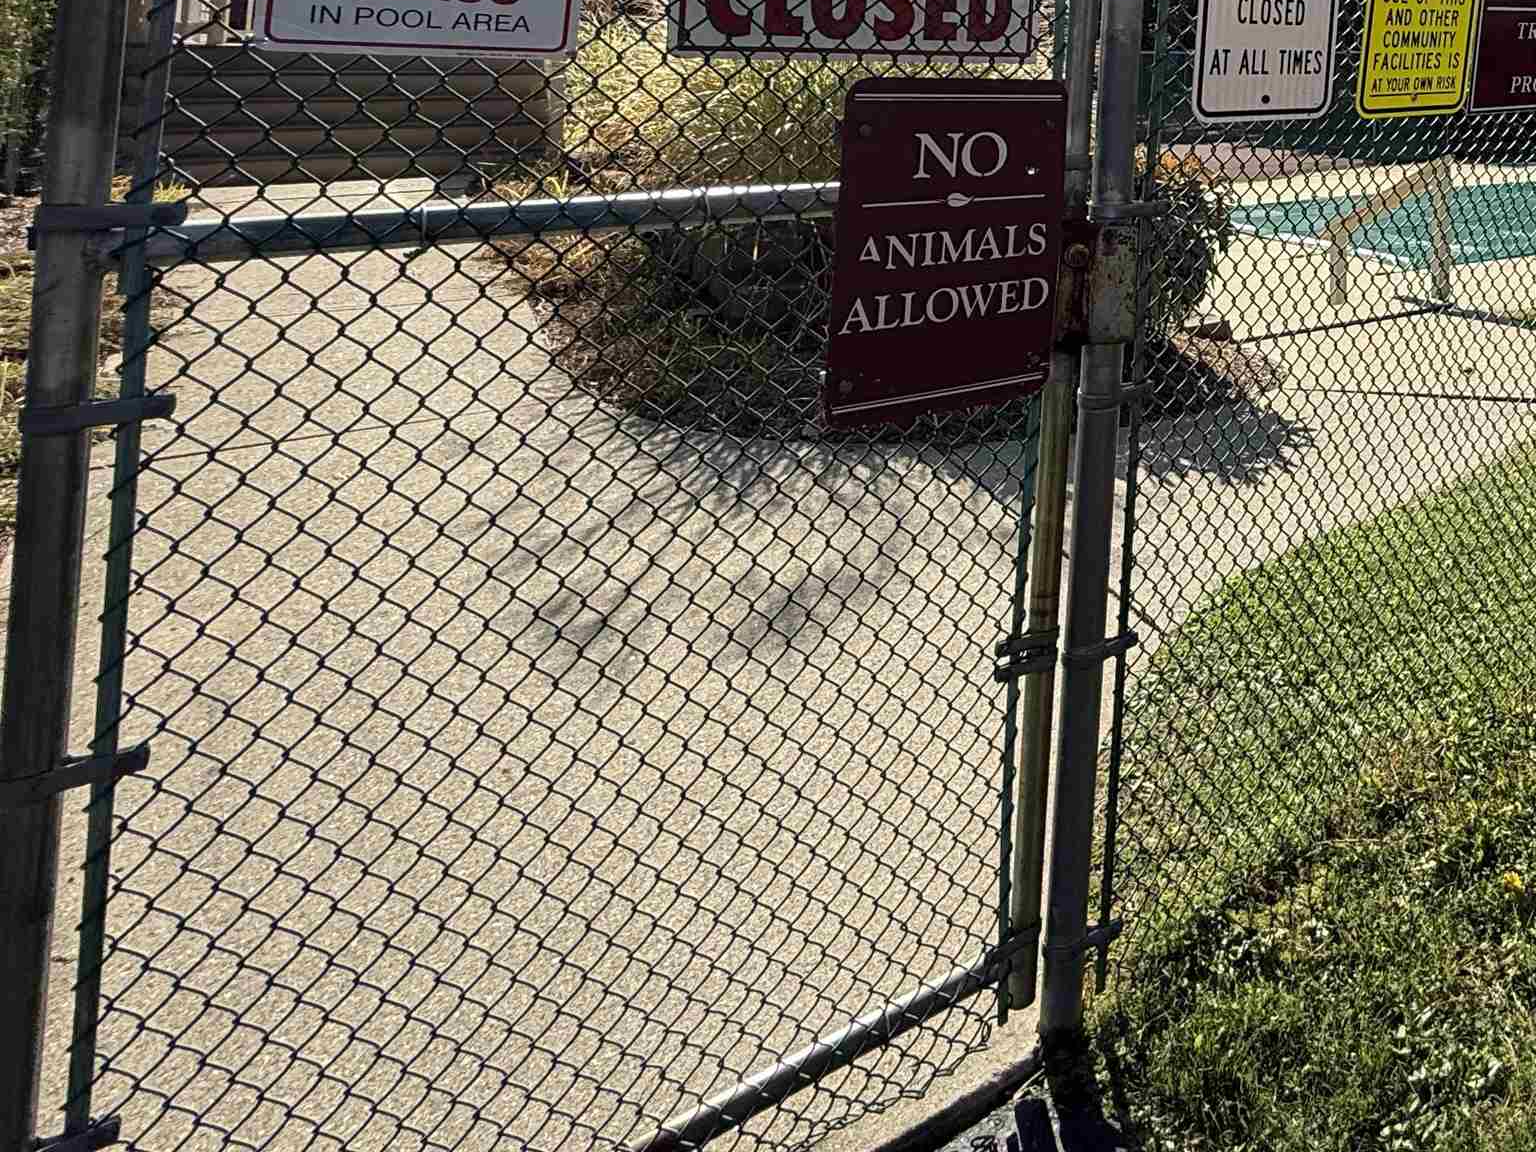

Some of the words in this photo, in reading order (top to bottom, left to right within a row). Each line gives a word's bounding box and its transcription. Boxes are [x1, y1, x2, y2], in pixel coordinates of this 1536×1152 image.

[310, 5, 342, 25] IN
[354, 8, 442, 30] POOL
[452, 12, 530, 33] AREA
[1385, 9, 1412, 26] AND
[1419, 9, 1459, 27] OTHER
[1383, 31, 1456, 49] COMMUNITY
[1209, 49, 1231, 76] AT
[1238, 49, 1269, 76] ALL
[1279, 48, 1322, 76] TIMES
[1373, 52, 1442, 71] FACILITIES
[1448, 52, 1460, 70] IS
[1371, 78, 1384, 93] AT
[1386, 77, 1410, 93] YOUR
[1413, 76, 1433, 91] OWN
[1436, 75, 1456, 90] RISK
[913, 131, 1008, 179] NO
[859, 223, 1047, 270] ANIMALS
[838, 277, 1049, 335] ALLOWED
